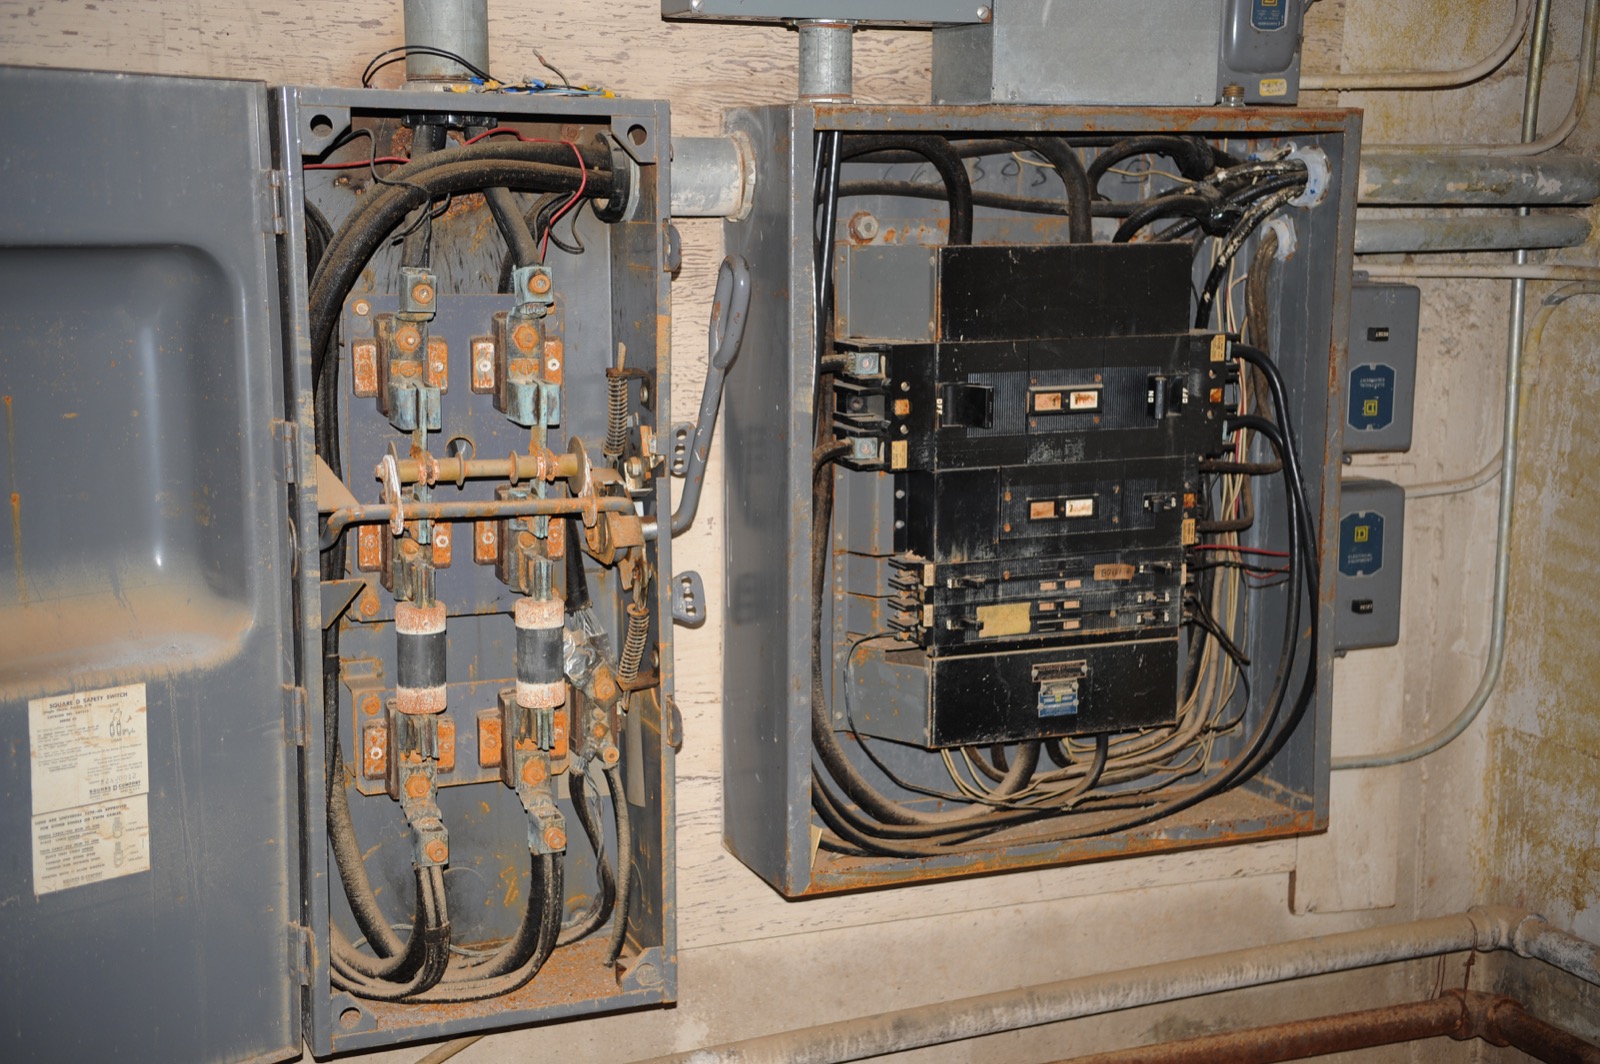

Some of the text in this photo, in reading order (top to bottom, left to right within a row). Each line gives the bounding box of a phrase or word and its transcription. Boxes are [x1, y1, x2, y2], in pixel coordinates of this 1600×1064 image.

[1148, 390, 1154, 403] ON
[49, 701, 73, 709] SQUARE
[106, 691, 128, 700] SWITCH
